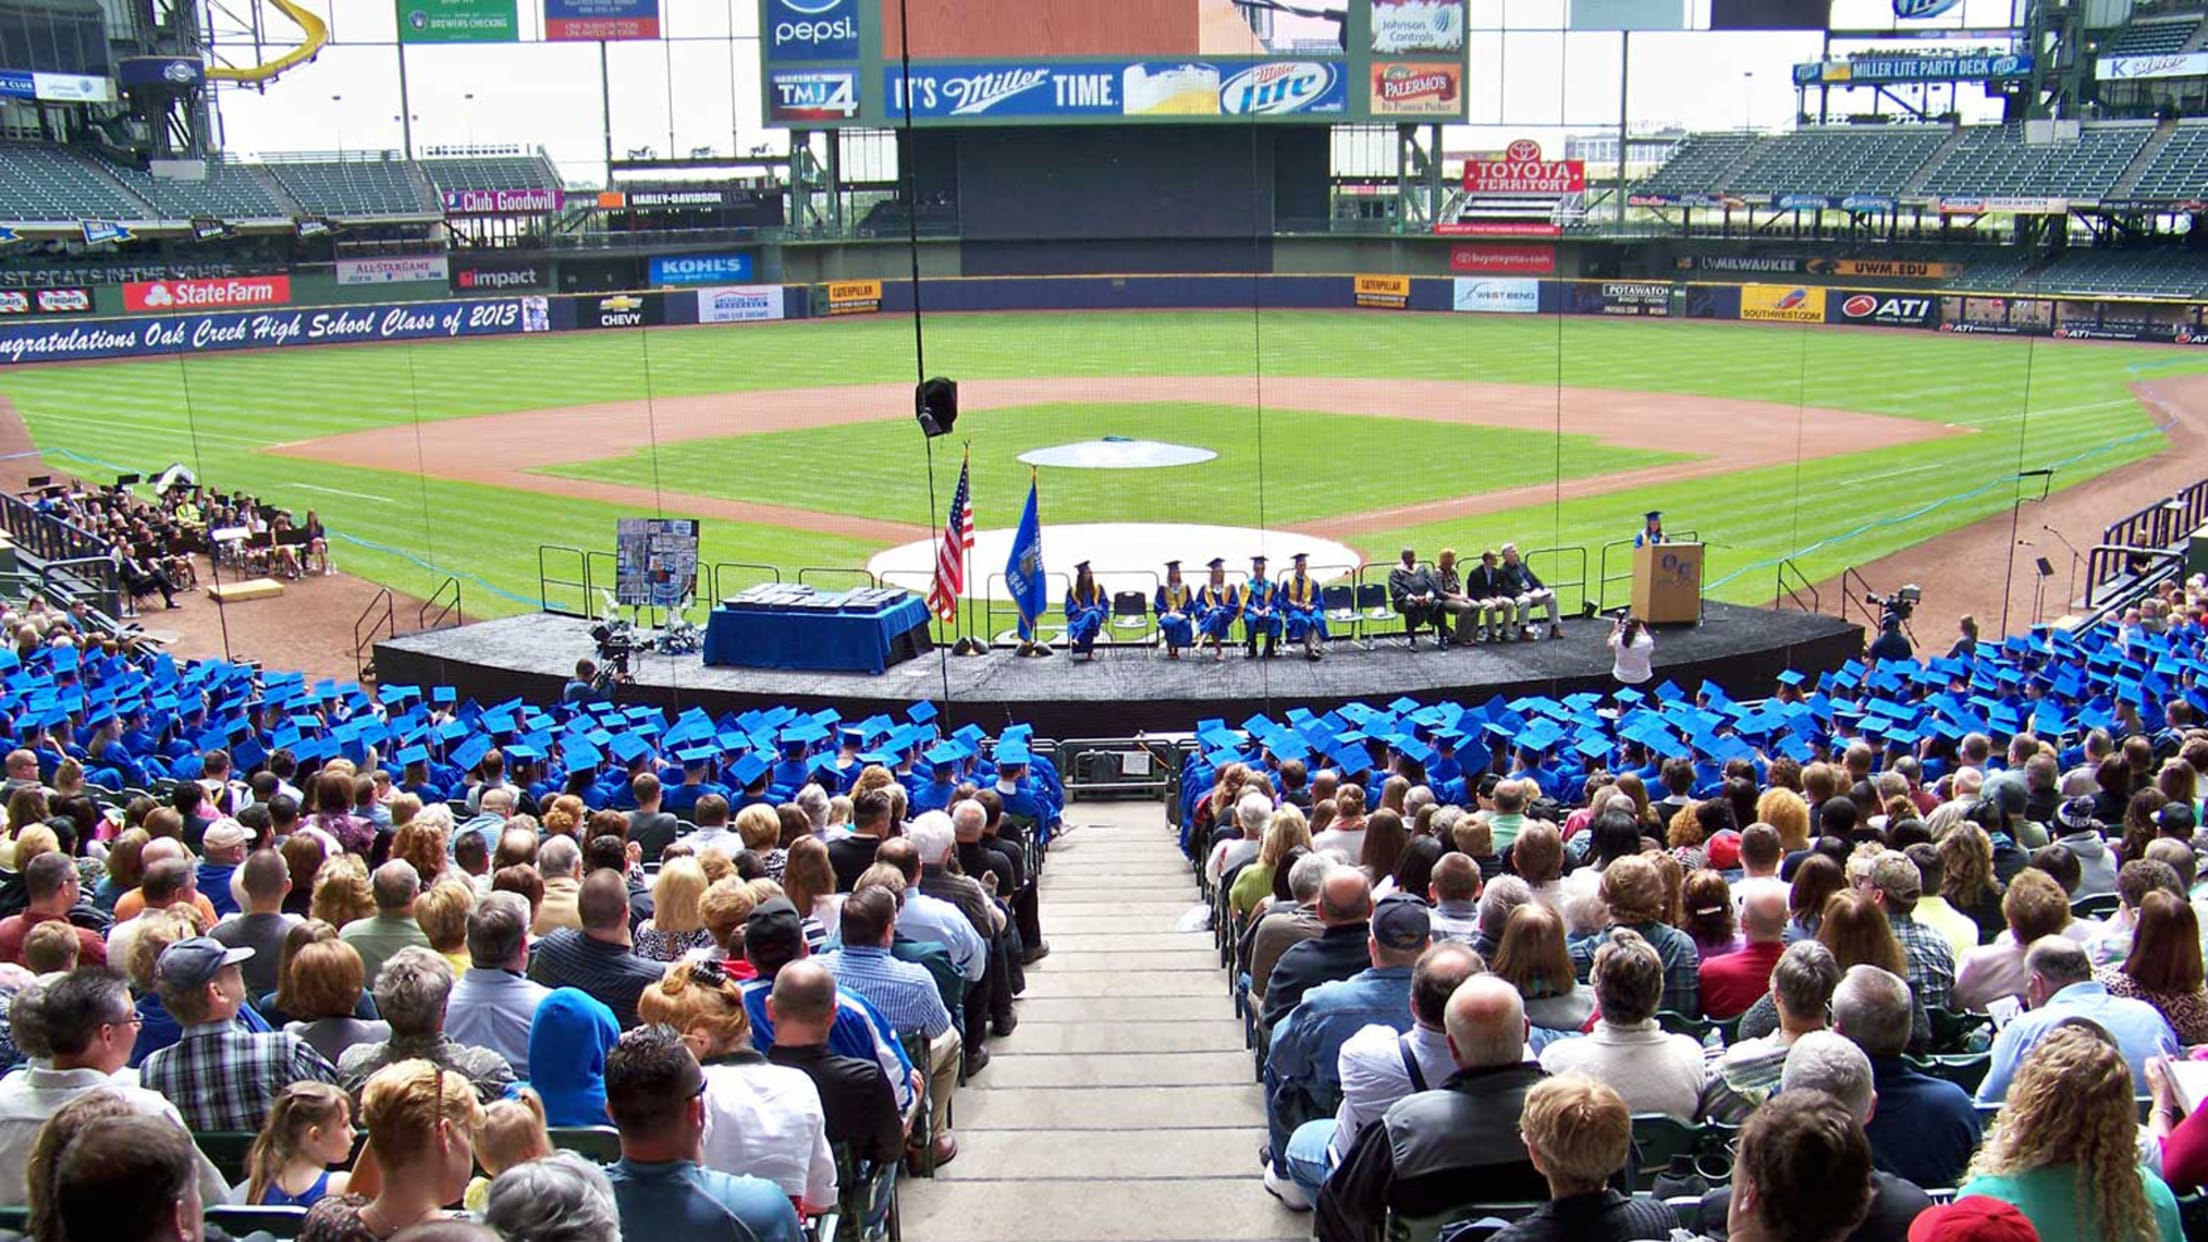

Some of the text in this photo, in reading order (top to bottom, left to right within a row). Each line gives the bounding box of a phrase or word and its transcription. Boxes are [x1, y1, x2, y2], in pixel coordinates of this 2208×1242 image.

[776, 16, 849, 46] pepsi
[1382, 18, 1425, 30] Johnson
[1389, 30, 1434, 42] Controls
[1852, 63, 1893, 78] MILLER
[1894, 62, 1918, 77] LITE
[1919, 60, 1956, 76] PARTY
[1958, 59, 1989, 74] DECK
[9, 81, 33, 89] CLUB
[894, 77, 937, 109] IT'S
[942, 68, 1049, 113] Miller
[1477, 162, 1571, 179] TOYOTA
[1477, 179, 1571, 191] TERRITORY
[463, 190, 556, 211] Club Goodwill
[632, 192, 721, 205] HARLEY-DAVIDSON
[662, 259, 742, 273] KOHL'S
[1855, 262, 1928, 276] UWM.EDU
[474, 268, 537, 288] impact
[1361, 279, 1401, 291] CATERPILLAR
[1477, 291, 1535, 301] WEST BEND
[1876, 298, 1930, 317] ATI
[601, 313, 642, 327] CHEVY
[1743, 309, 1822, 321] SOUTHWEST.COM
[144, 321, 186, 346] Oak
[193, 318, 247, 348] Creek
[252, 312, 302, 344] High
[308, 311, 374, 337] School
[381, 308, 435, 336] Class
[443, 307, 463, 335] of
[469, 303, 519, 328] 2013
[1953, 324, 1974, 333] ATI
[2068, 330, 2090, 339] ATI
